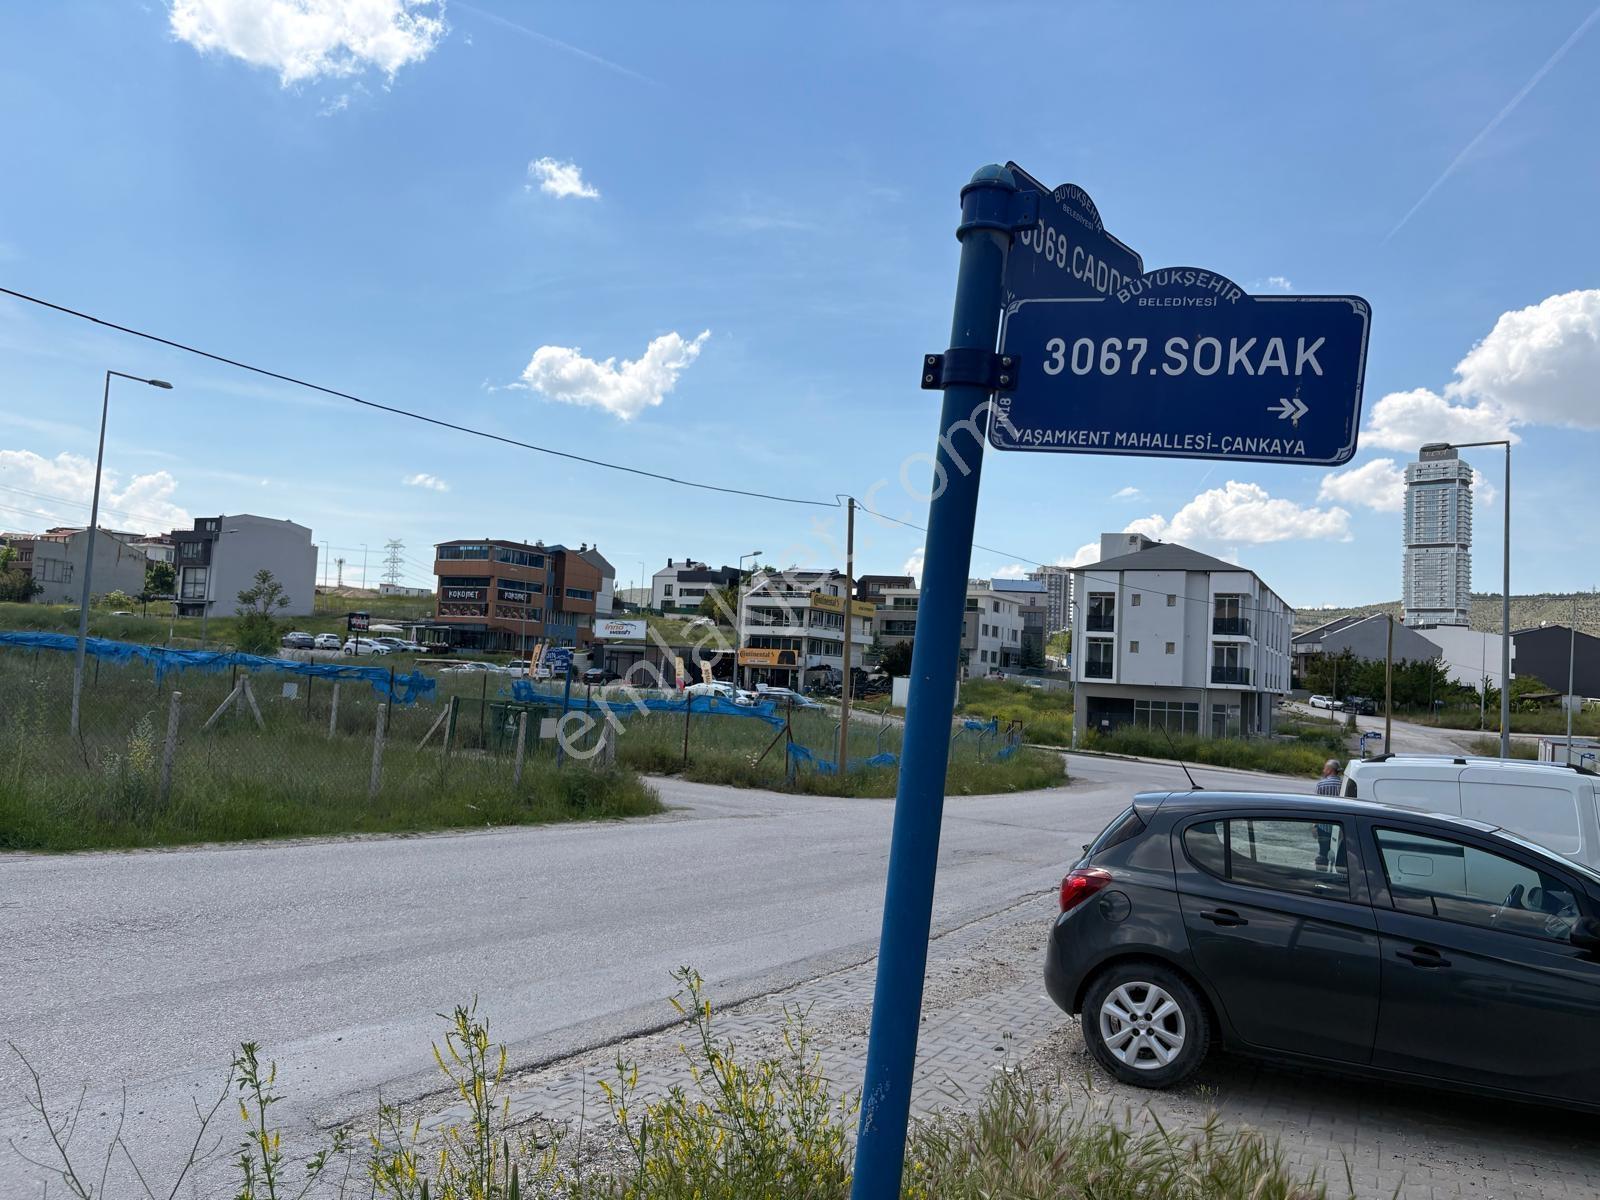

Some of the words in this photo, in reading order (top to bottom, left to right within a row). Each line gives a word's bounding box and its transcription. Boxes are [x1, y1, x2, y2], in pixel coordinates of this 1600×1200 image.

[1062, 203, 1094, 231] BELEDİYESİ
[1020, 218, 1132, 296] 069.CADD
[1116, 269, 1242, 305] BÜYÜKŞEHİR
[1138, 296, 1218, 307] BELEDİYESİ
[1043, 337, 1326, 376] 3067.SOKAK
[1014, 428, 1111, 447] YAŞAMKENT
[1114, 431, 1306, 455] MAHALLESİ-ÇANKAYA
